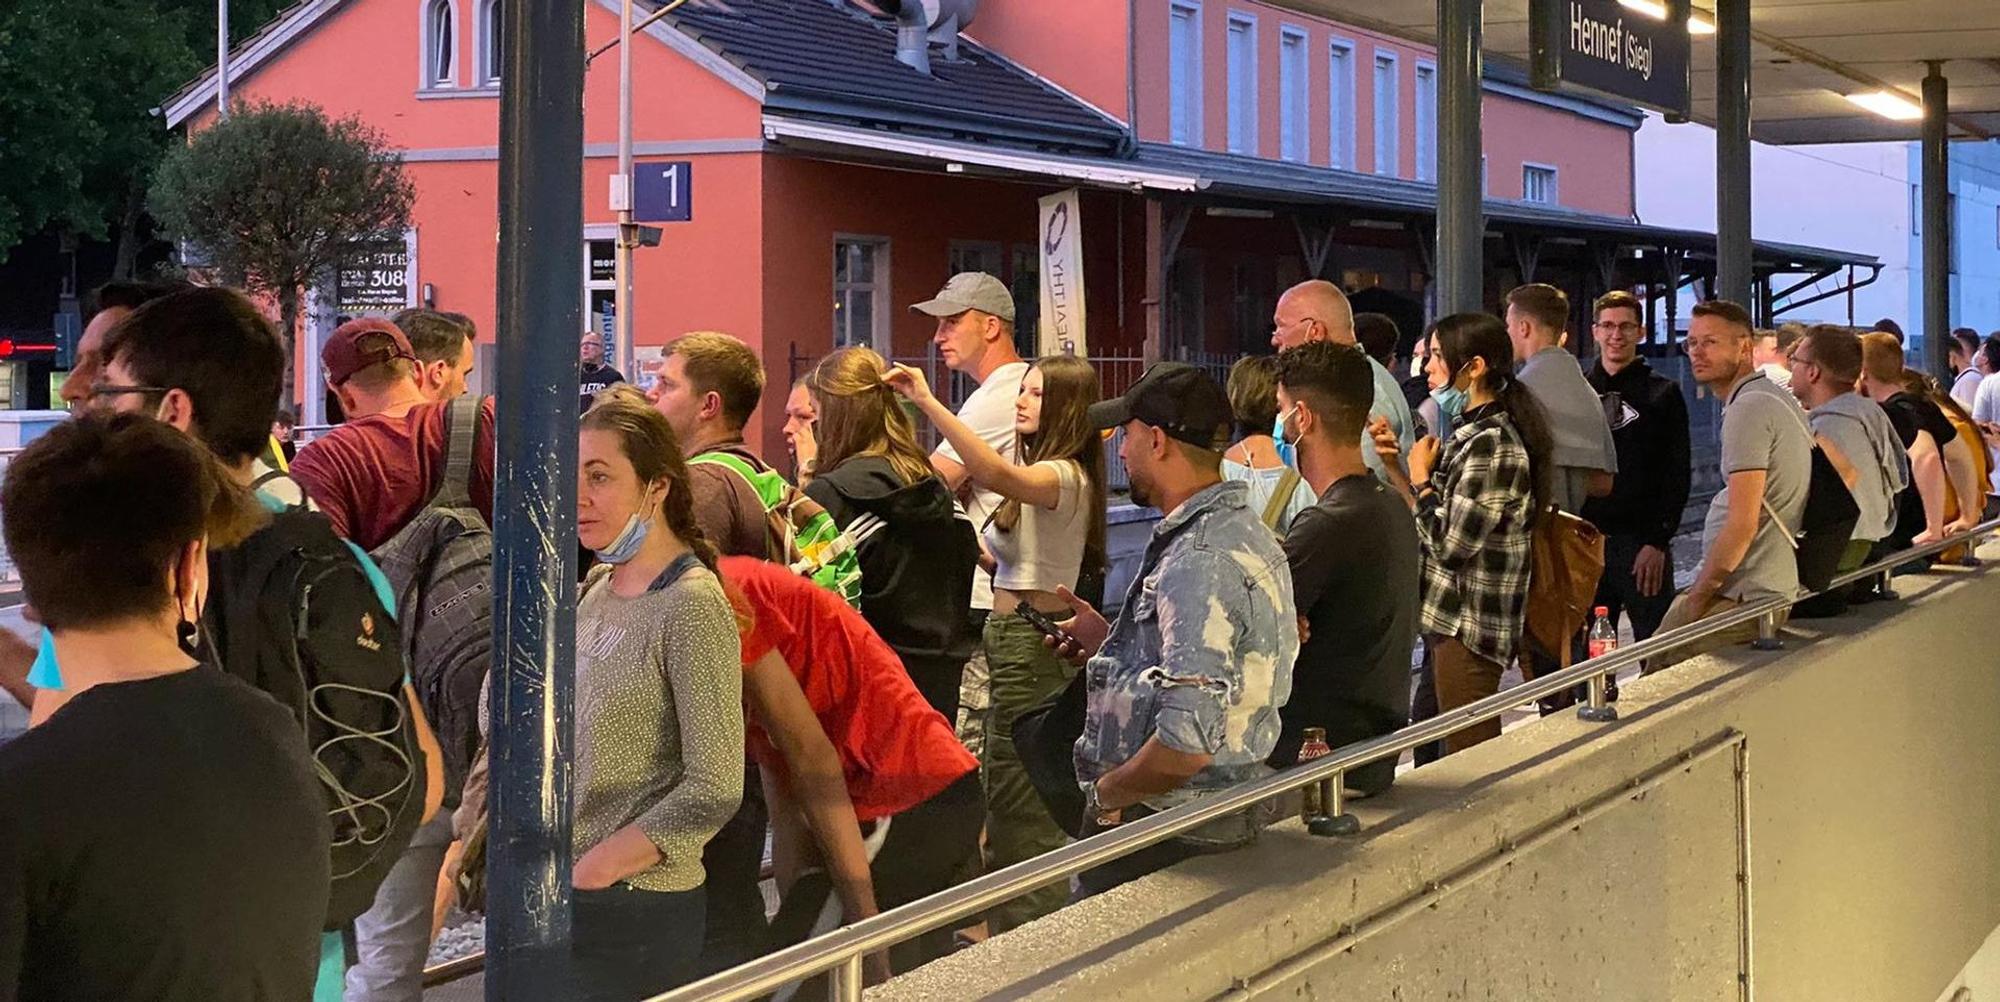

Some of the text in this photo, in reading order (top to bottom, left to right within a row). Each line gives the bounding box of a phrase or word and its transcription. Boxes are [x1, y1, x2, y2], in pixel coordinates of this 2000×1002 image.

[1570, 1, 1652, 80] Hennef (Sieg)
[662, 164, 677, 207] 1
